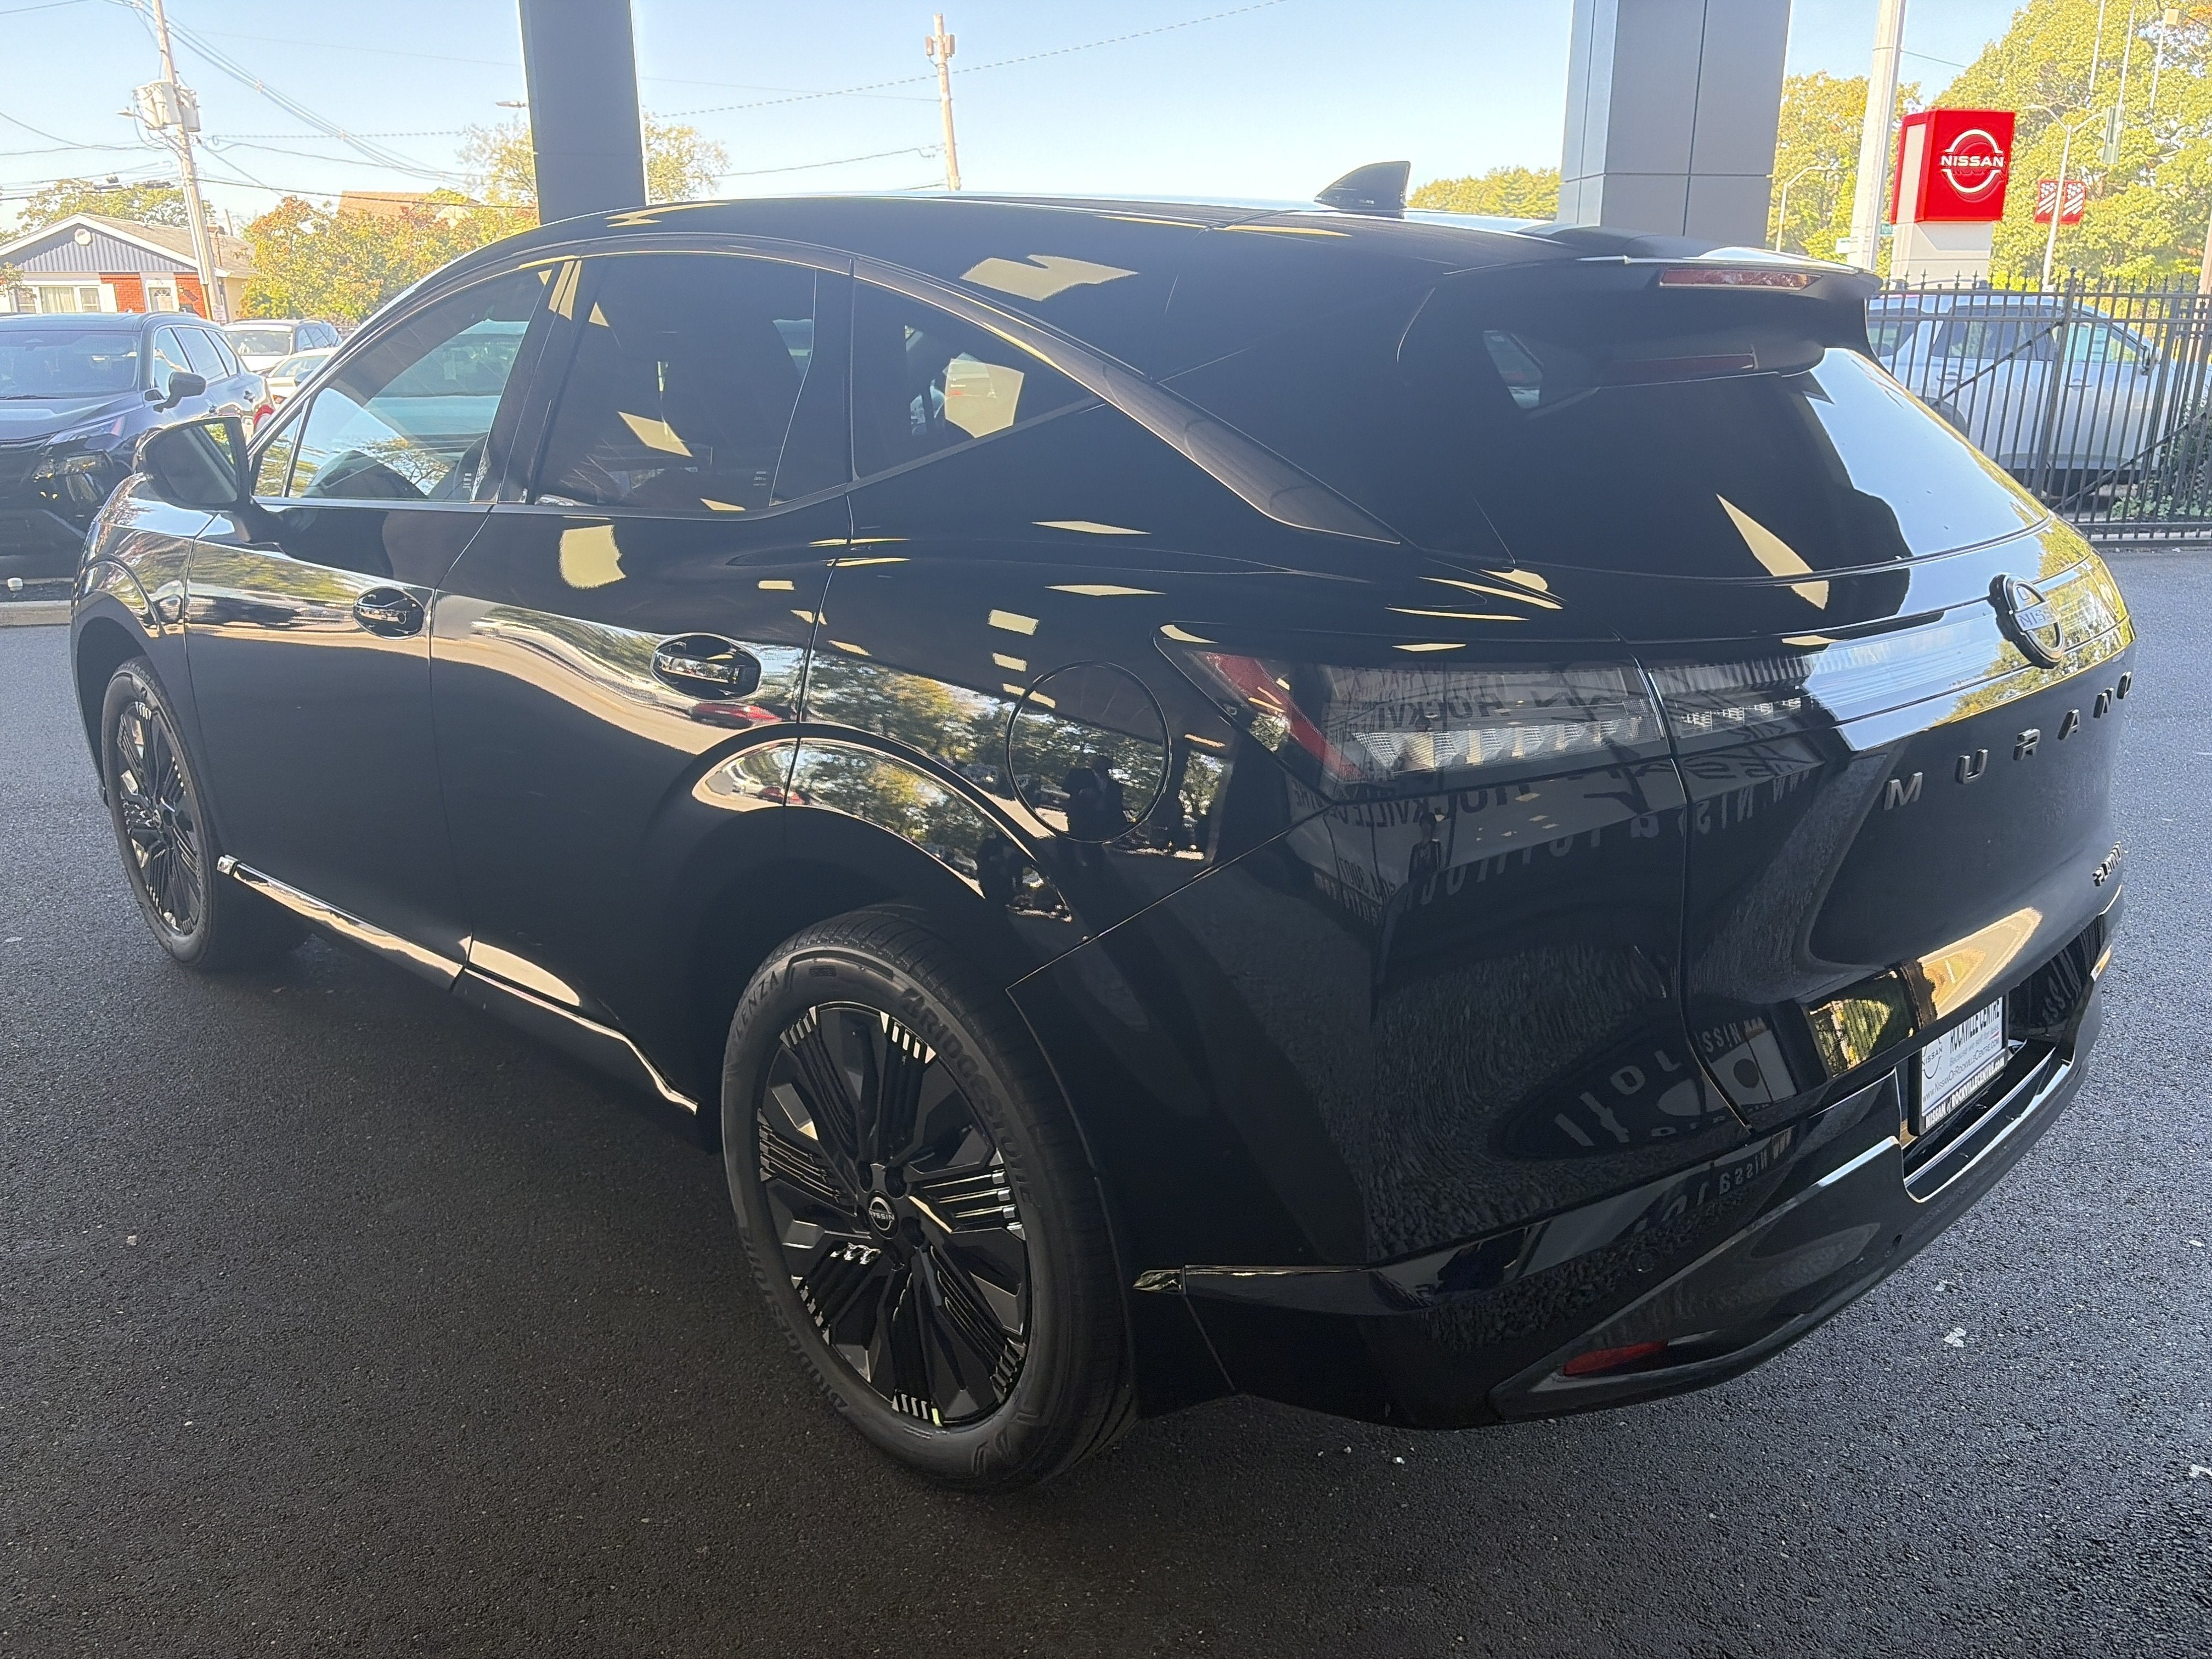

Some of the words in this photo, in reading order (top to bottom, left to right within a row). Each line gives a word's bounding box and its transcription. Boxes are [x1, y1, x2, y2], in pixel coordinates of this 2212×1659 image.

[1940, 155, 2004, 167] NISSAN
[1883, 670, 2132, 811] MURANO
[1926, 1101, 1946, 1129] NISSAN
